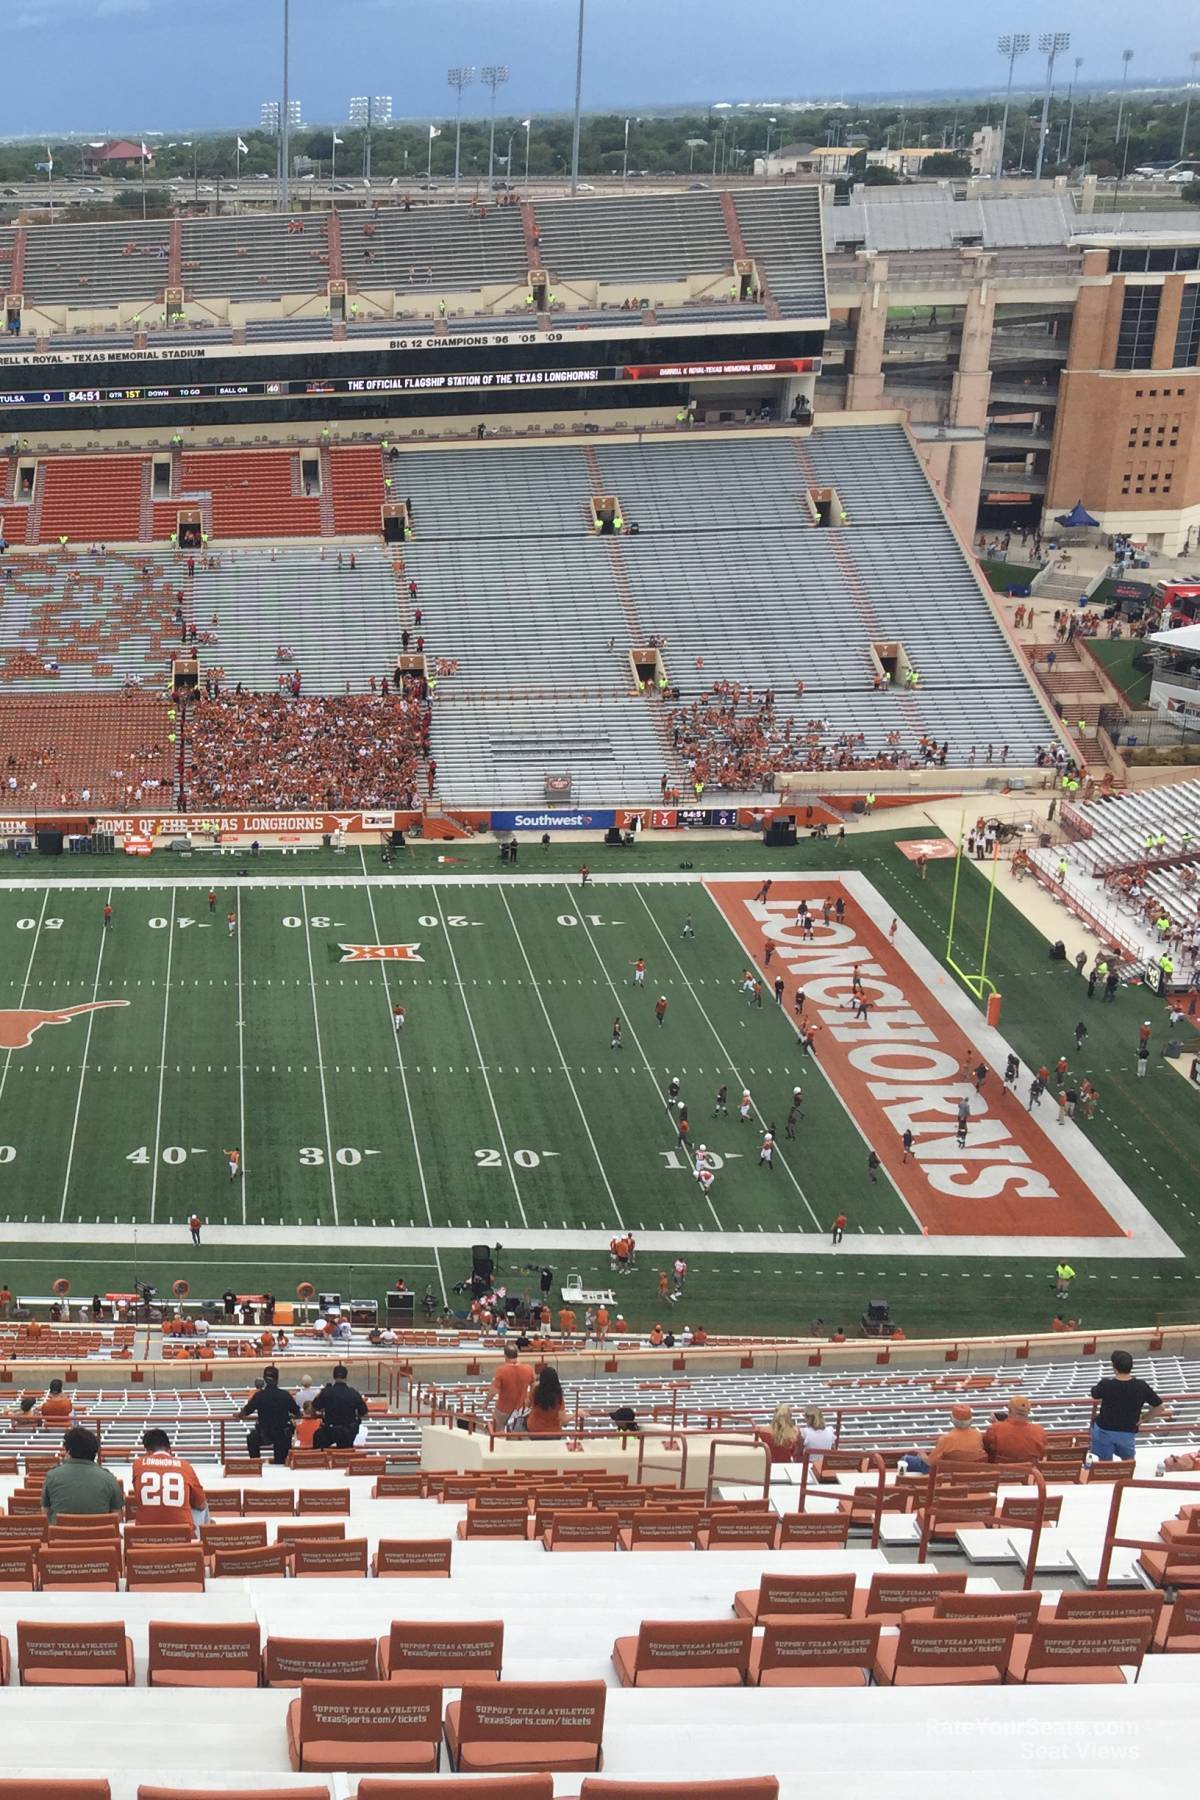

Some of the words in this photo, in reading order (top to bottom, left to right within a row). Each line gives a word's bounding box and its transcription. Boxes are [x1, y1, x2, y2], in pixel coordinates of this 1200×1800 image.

[389, 340, 408, 349] BIG
[411, 339, 423, 348] 12
[426, 336, 488, 347] CHAMPIONS
[491, 335, 509, 344] '96
[519, 334, 536, 343] '05
[545, 333, 563, 342] '09
[22, 356, 31, 365] K
[32, 354, 63, 364] ROYAL
[72, 353, 105, 362] TEXAS
[107, 350, 159, 361] MEMORIAL
[161, 349, 205, 359] STADIUM
[347, 380, 365, 391] THE
[366, 379, 403, 390] OFFICIAL
[404, 376, 445, 388] FLAGSHIP
[447, 374, 481, 386] STATION
[482, 374, 494, 385] OF
[496, 373, 512, 384] THE
[514, 372, 543, 383] TEXAS
[544, 370, 599, 382] LONGHORNS!
[68, 390, 100, 402] 84:51
[125, 390, 141, 399] 1ST
[148, 390, 169, 398] DOWN
[237, 386, 248, 394] ON
[0, 395, 25, 403] TULSA
[43, 393, 51, 402] 0
[138, 818, 156, 831] OF
[160, 819, 189, 831] THE
[243, 816, 324, 830] LONGHORNS
[514, 815, 583, 827] Southwest
[661, 818, 668, 826] 0
[15, 918, 65, 930] 50
[147, 917, 197, 929] 40
[281, 916, 331, 928] 30
[417, 915, 469, 928] 20
[556, 914, 607, 927] 10
[742, 898, 1060, 1199] LONGHORNS
[125, 1146, 188, 1165] 40
[298, 1147, 362, 1166] 30
[474, 1148, 541, 1168] 20
[141, 1472, 185, 1507] 28
[312, 1704, 350, 1714] SUPPORT
[353, 1705, 381, 1714] TEXAS
[382, 1704, 431, 1714] ATHLETICS
[475, 1705, 514, 1715] SUPPORT
[515, 1706, 546, 1715] TEXAS
[548, 1706, 596, 1716] ATHLETICS
